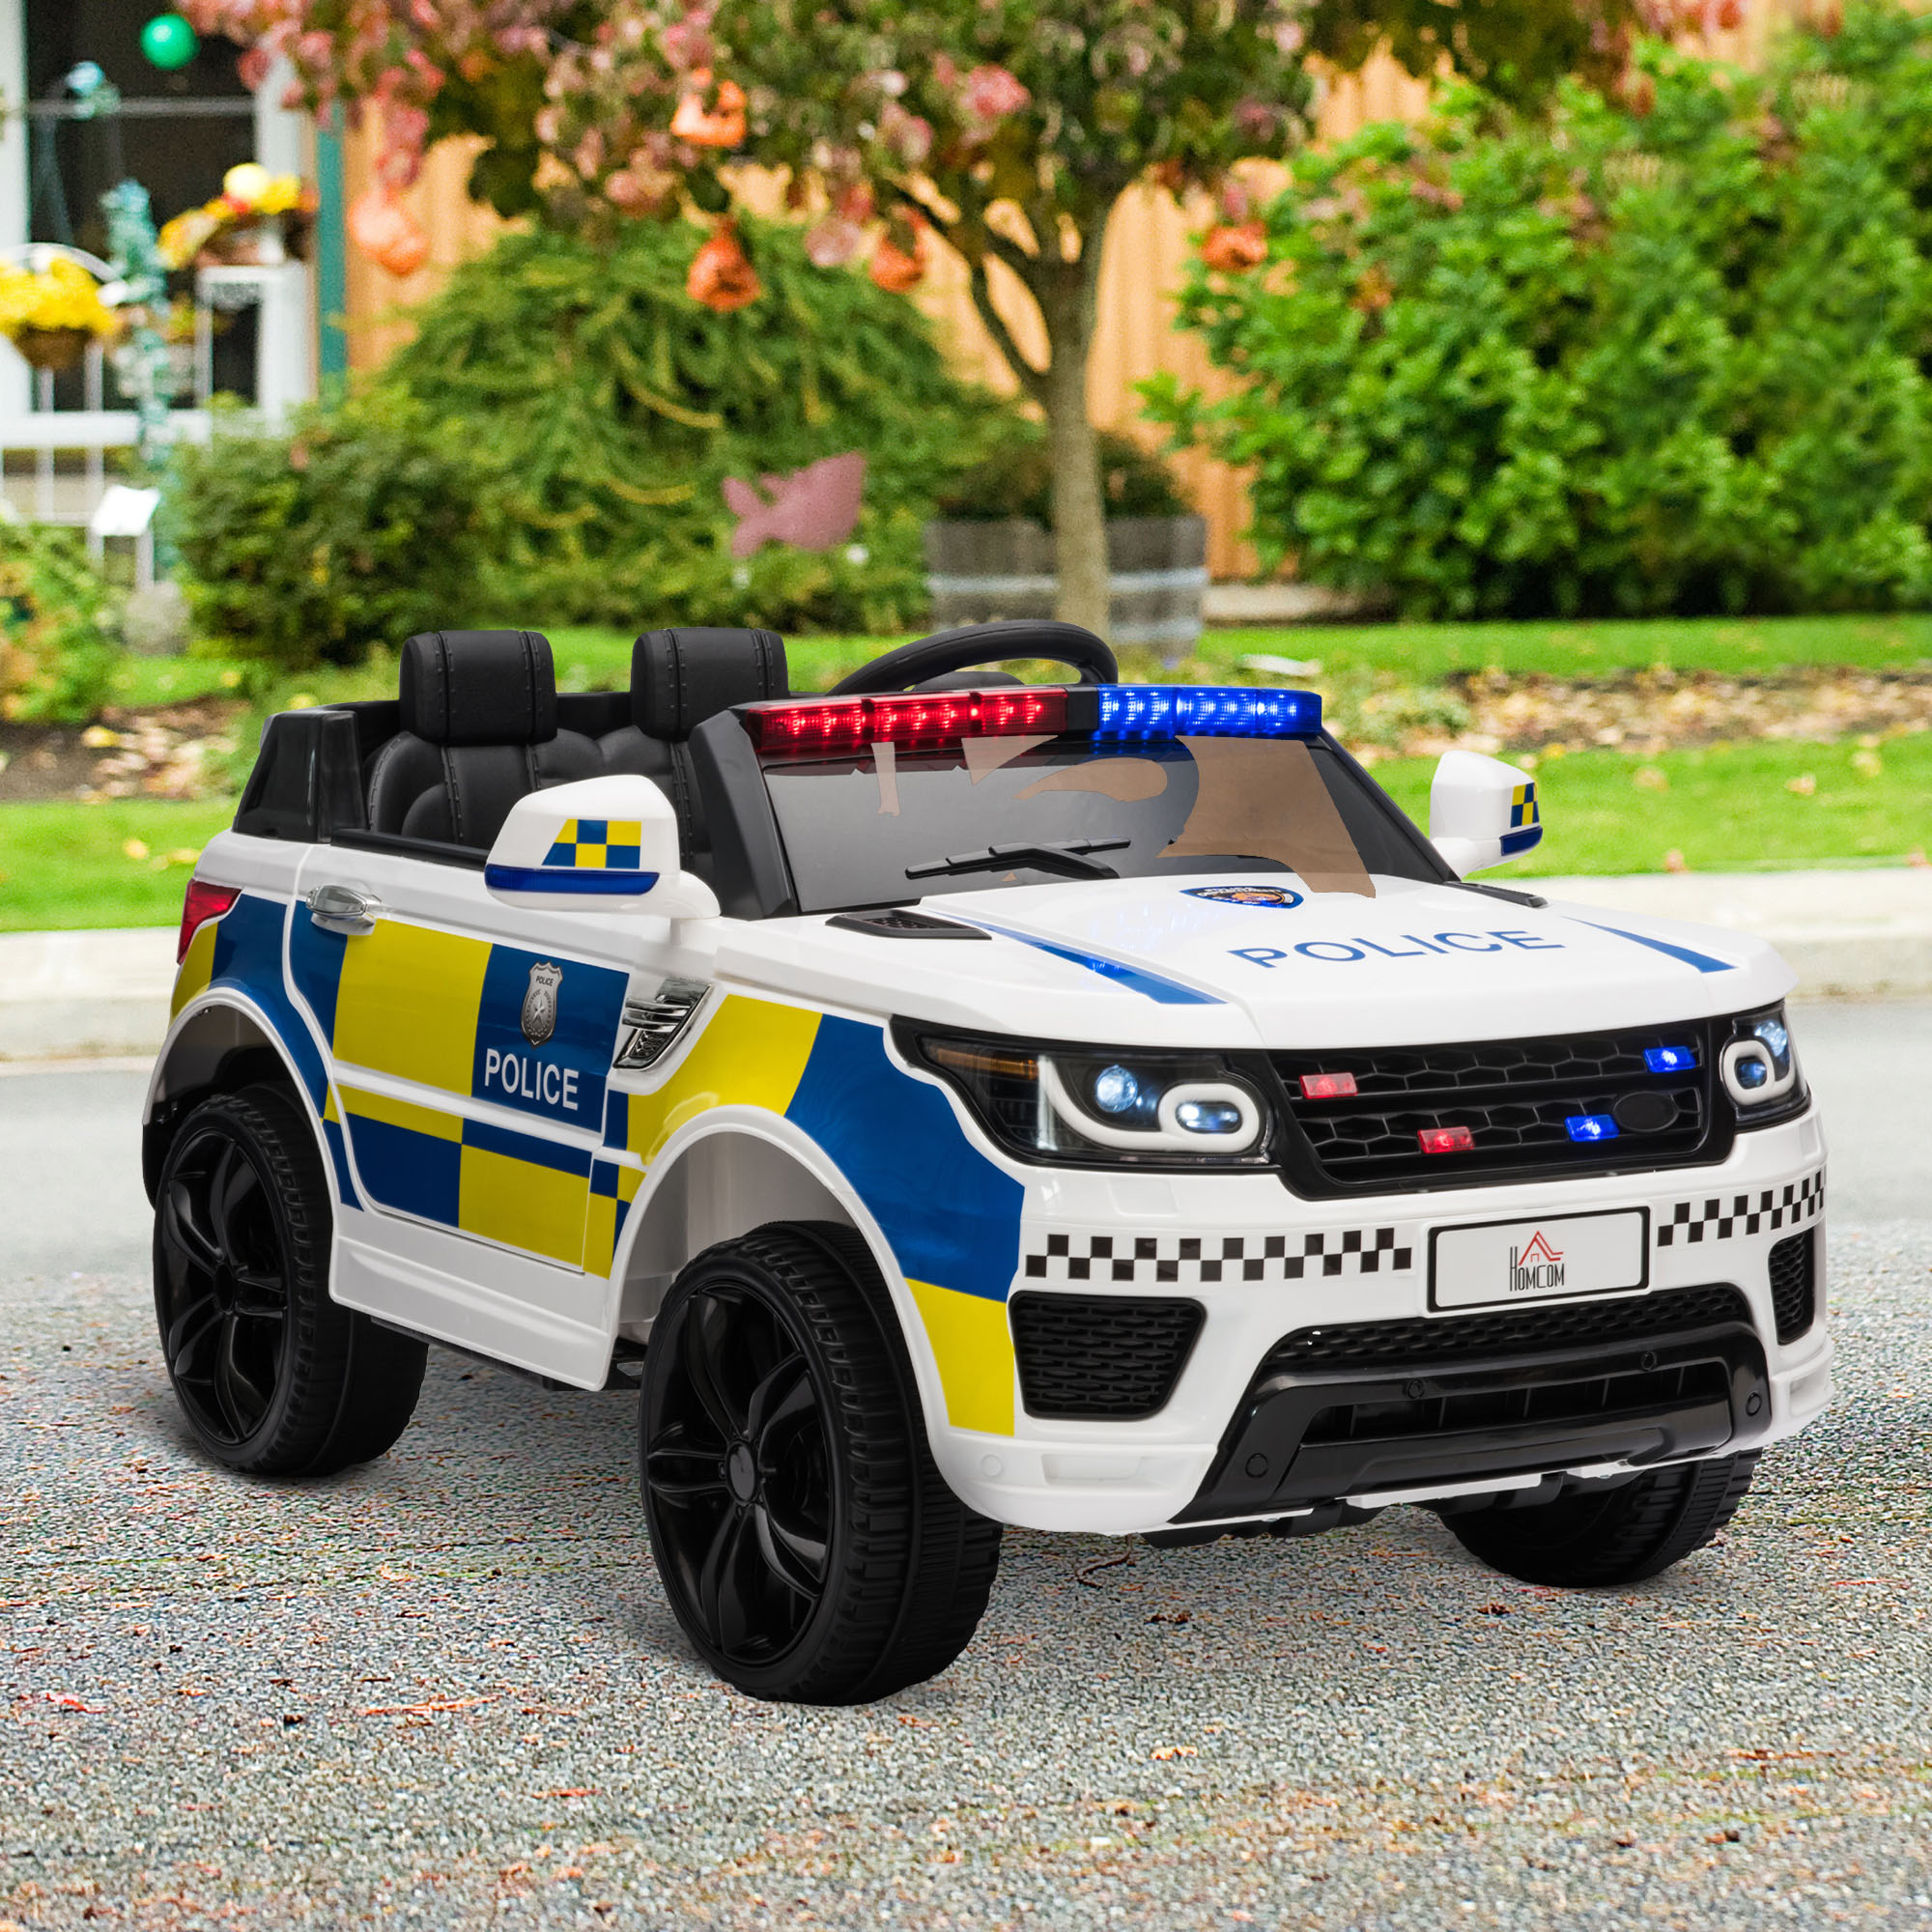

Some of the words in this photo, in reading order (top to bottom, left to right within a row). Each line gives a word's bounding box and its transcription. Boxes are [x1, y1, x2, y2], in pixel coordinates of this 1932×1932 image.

[1227, 930, 1566, 968] POLICE
[535, 975, 554, 986] POLICE
[484, 1047, 580, 1111] POLICE
